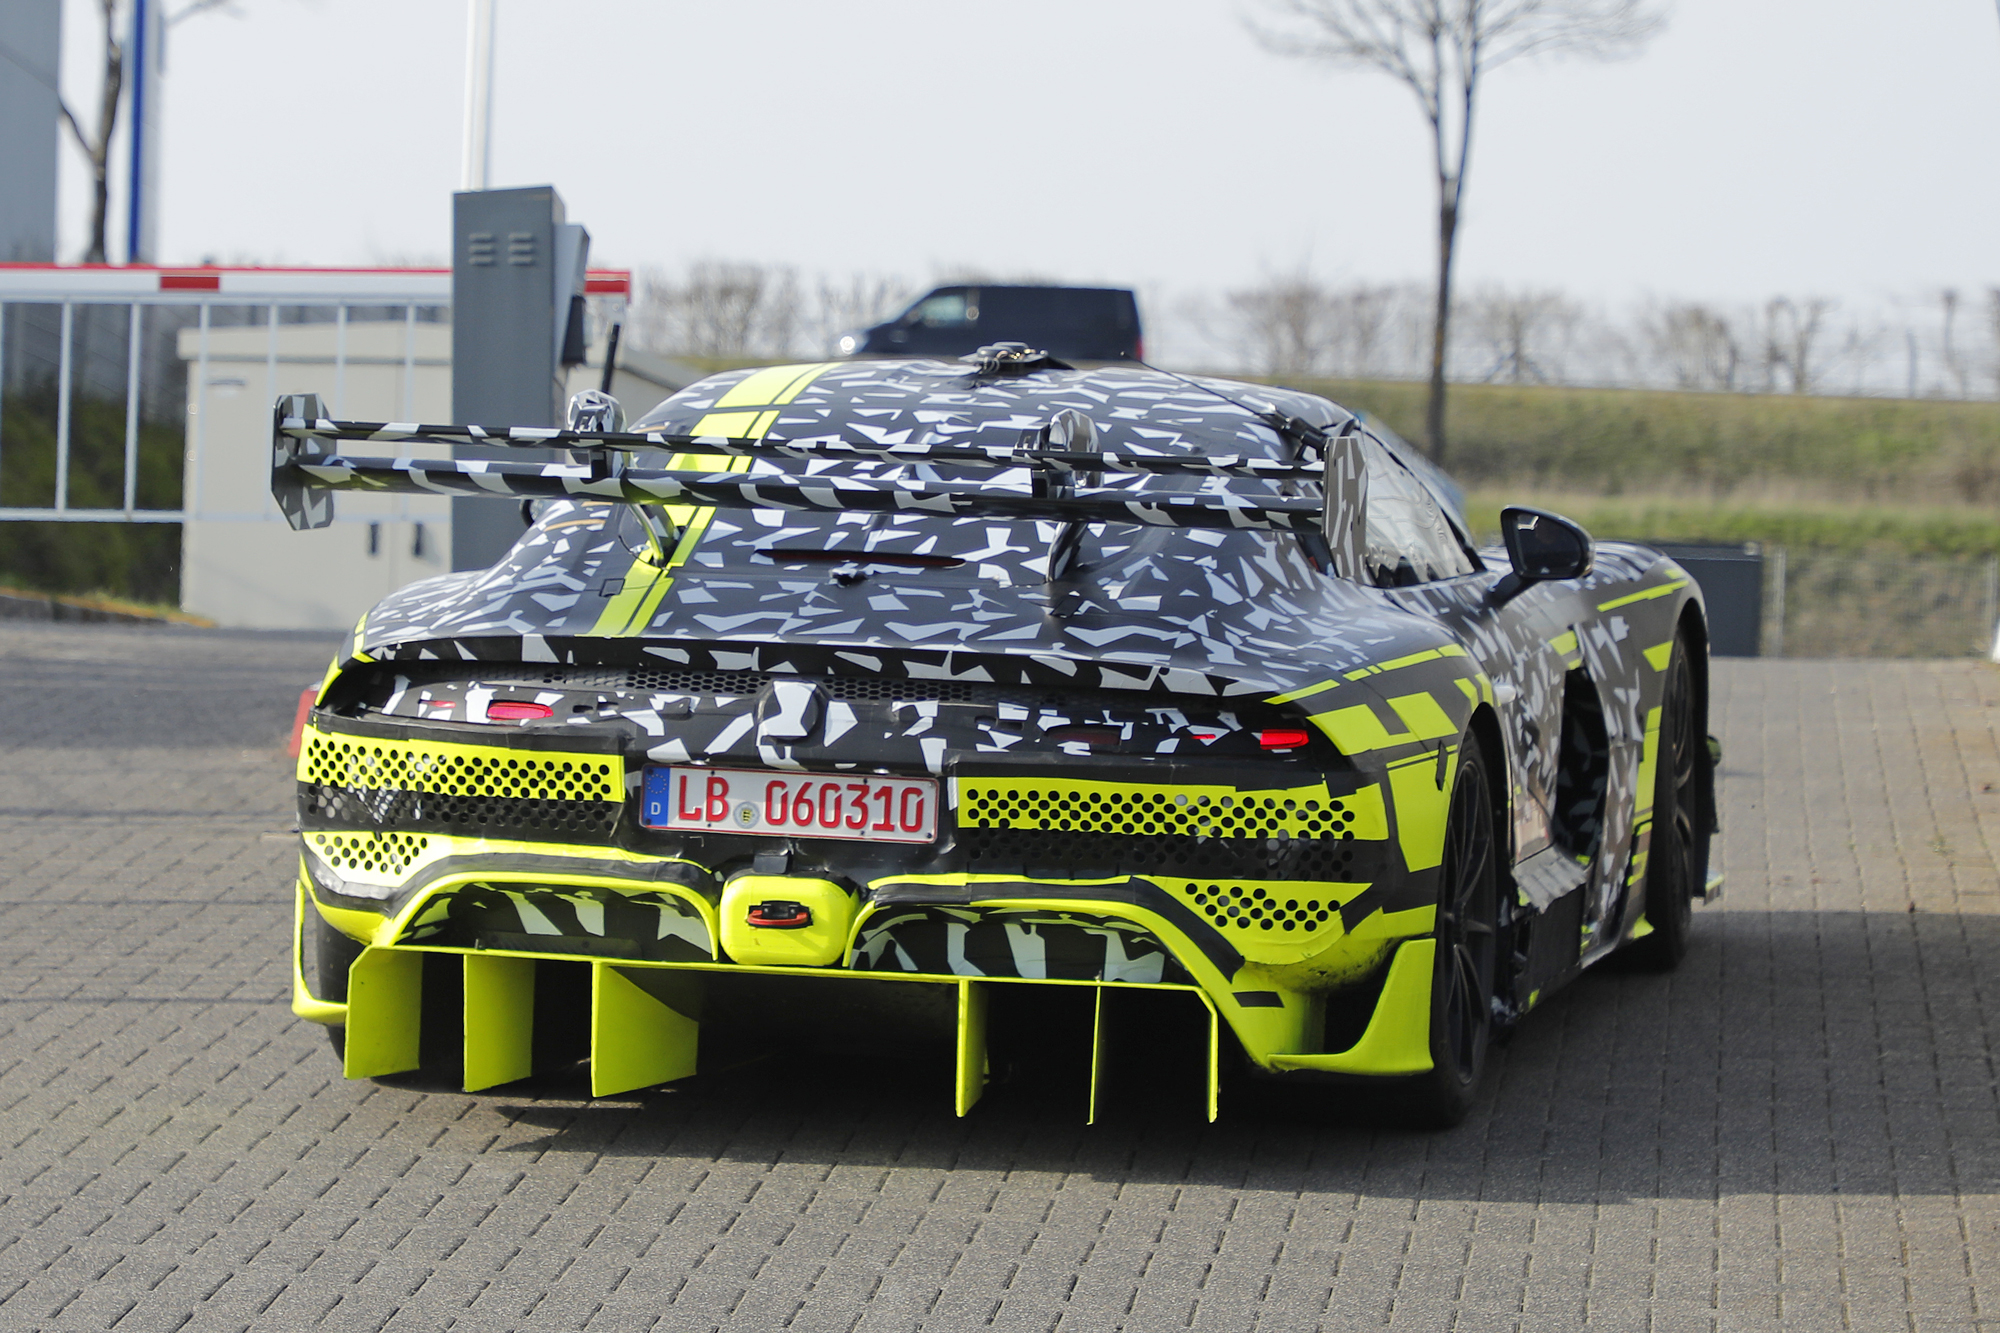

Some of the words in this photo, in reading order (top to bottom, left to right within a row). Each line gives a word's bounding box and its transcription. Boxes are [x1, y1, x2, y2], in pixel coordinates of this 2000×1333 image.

[650, 801, 661, 815] D
[678, 775, 729, 822] LB
[765, 780, 924, 833] 060310
